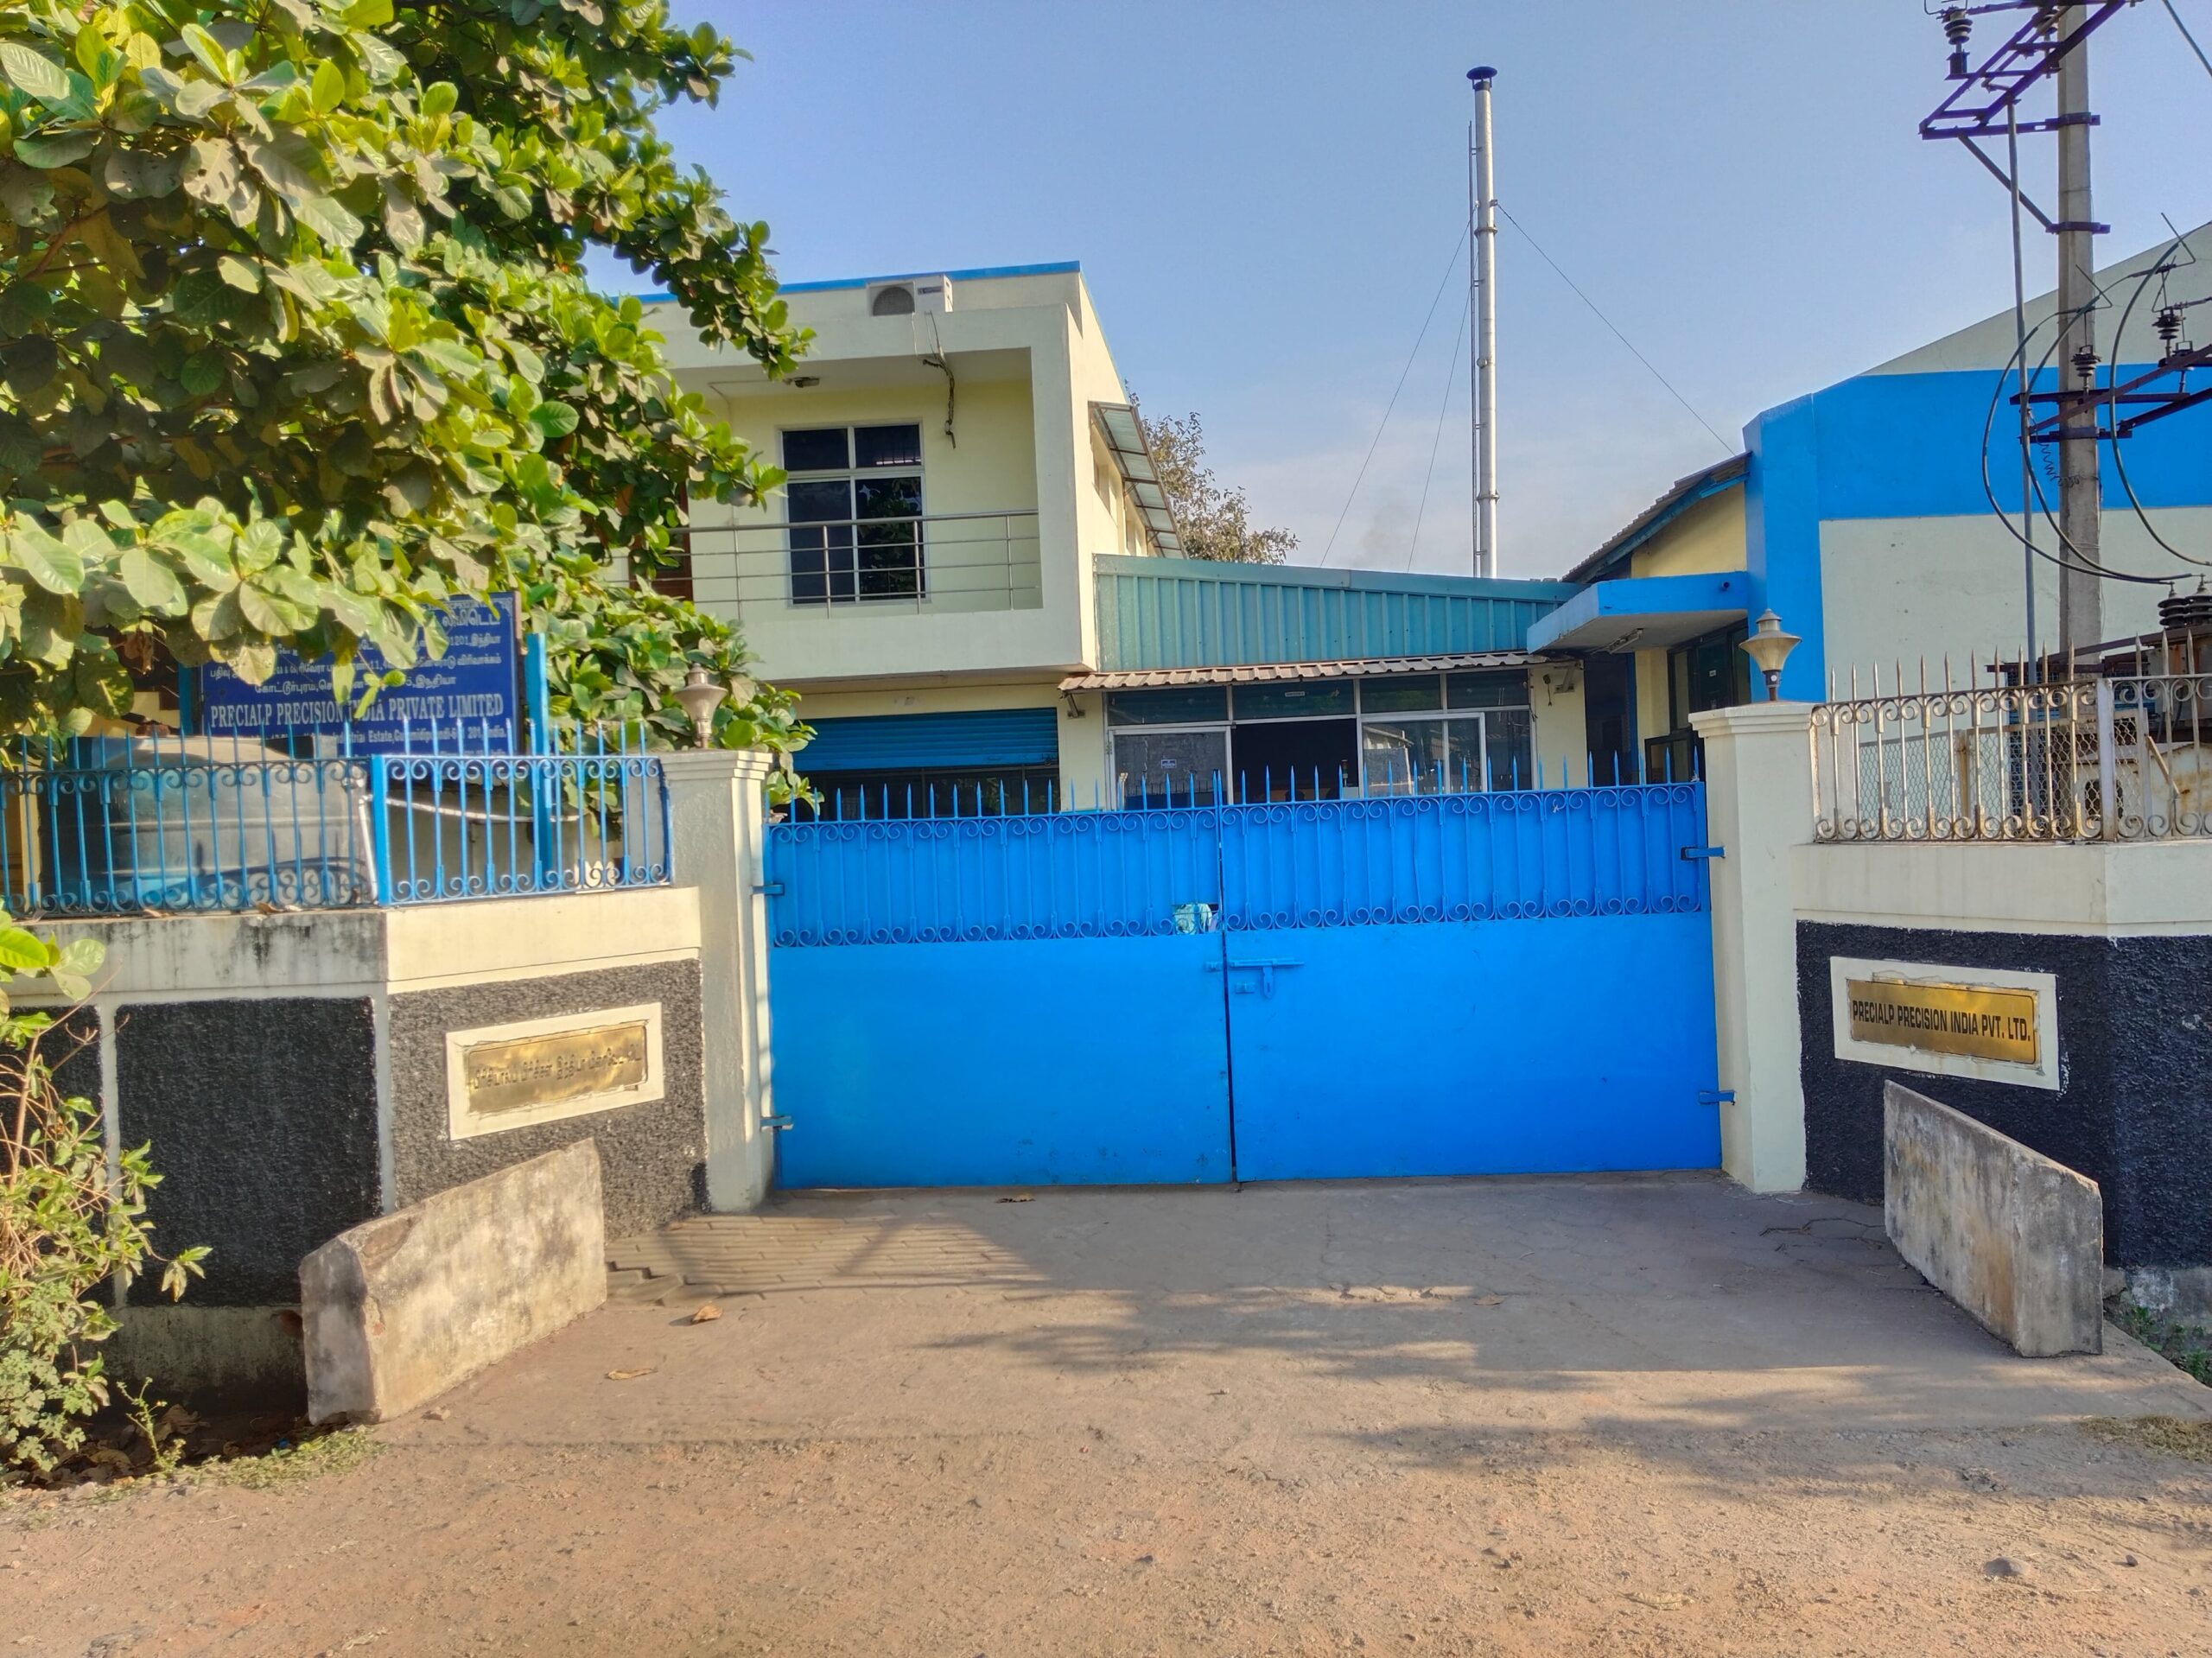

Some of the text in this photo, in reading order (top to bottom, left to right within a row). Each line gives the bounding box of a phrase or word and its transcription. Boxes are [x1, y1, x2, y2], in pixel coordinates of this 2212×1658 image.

[276, 700, 343, 726] PRECISION
[389, 696, 444, 721] PRIVATE
[448, 693, 504, 718] LIMITED
[1853, 1000, 2031, 1042] PRECIALP PRECISION INDIA PVT. LTD.
